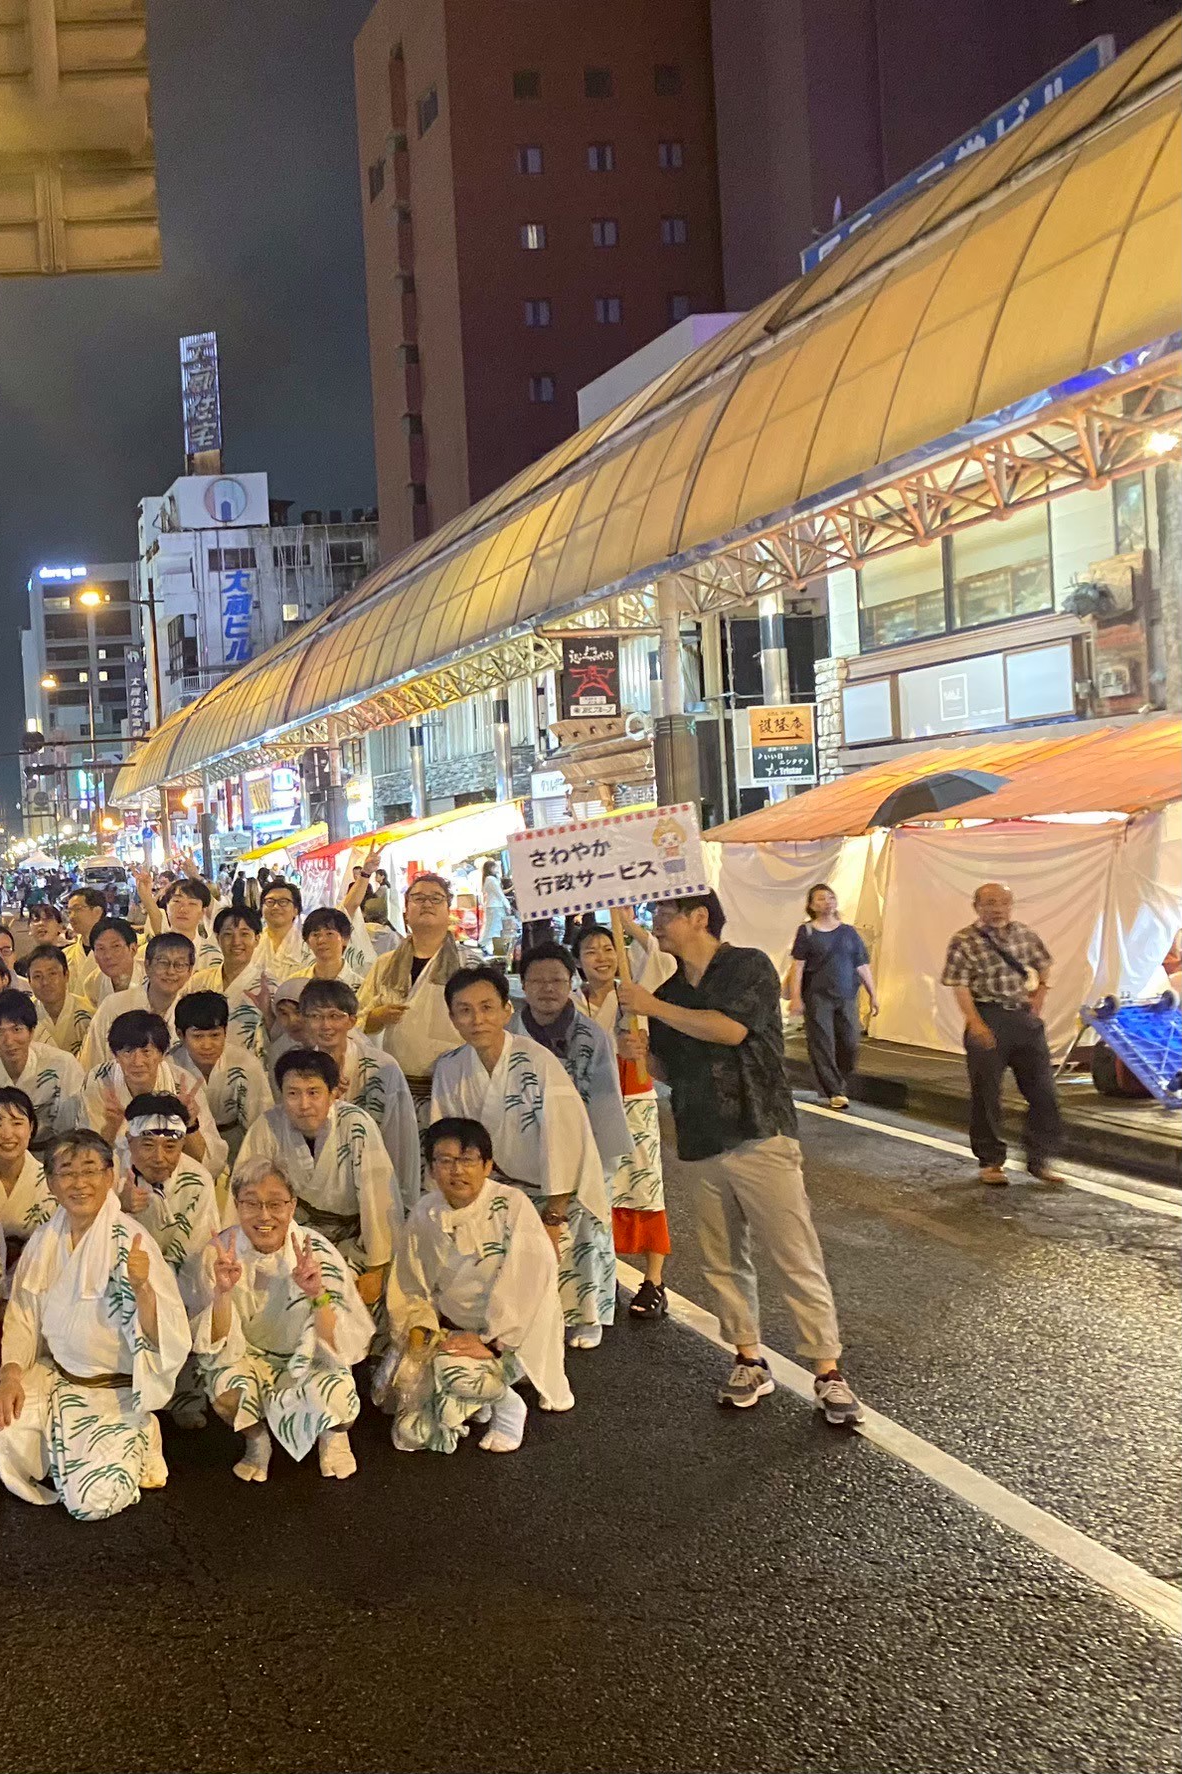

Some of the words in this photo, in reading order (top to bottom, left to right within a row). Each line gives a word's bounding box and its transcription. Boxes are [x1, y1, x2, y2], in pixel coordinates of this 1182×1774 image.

[221, 570, 253, 661] 大蔵ビル
[529, 839, 611, 867] さわやか
[533, 860, 658, 896] 行政サービス
